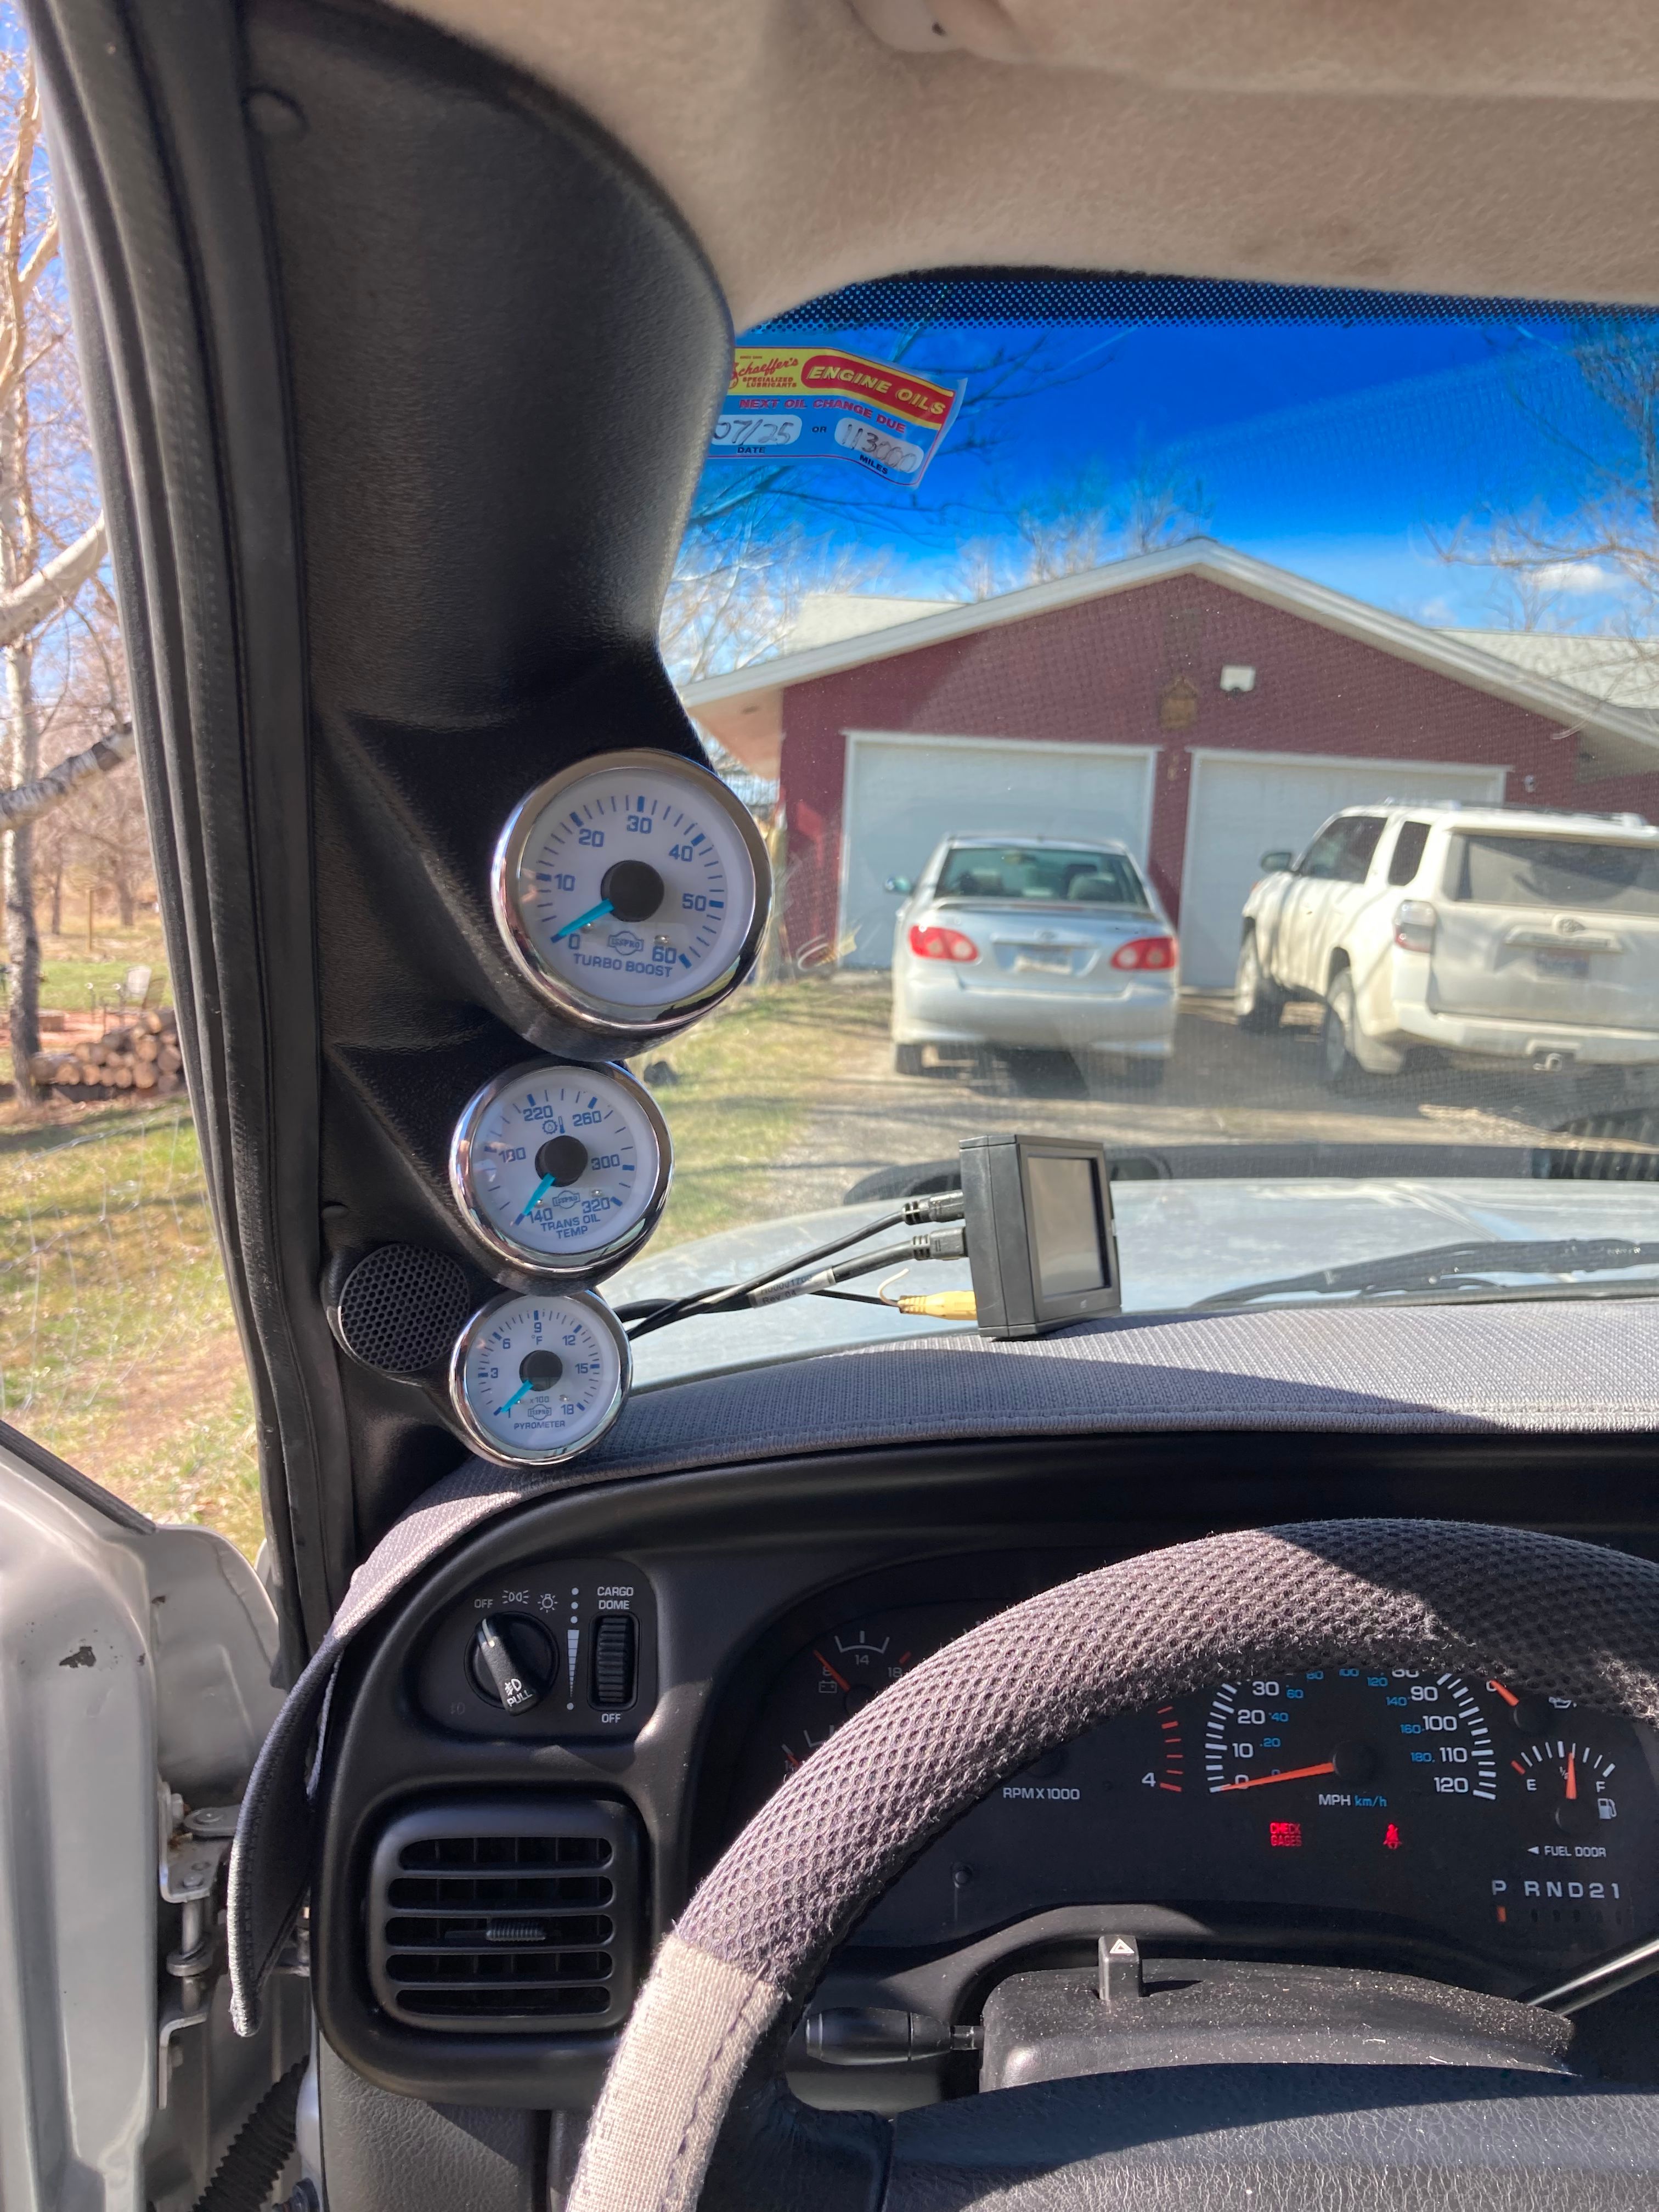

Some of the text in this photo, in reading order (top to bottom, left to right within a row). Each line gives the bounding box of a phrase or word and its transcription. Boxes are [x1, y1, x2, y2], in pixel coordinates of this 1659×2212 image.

[806, 366, 946, 415] ENGINE OILS
[739, 399, 906, 433] NEXT OIL CHANGE DUE
[714, 419, 794, 446] 07/25
[842, 424, 917, 472] 113000
[859, 454, 888, 475] MILES
[626, 816, 652, 834] 30
[578, 828, 605, 848] 20
[669, 844, 693, 862] 40
[554, 873, 575, 891] 10
[682, 893, 707, 912] 50
[568, 934, 580, 950] 0
[652, 946, 677, 964] 60
[573, 953, 674, 978] TURBO BOOST
[523, 1105, 554, 1121] 220
[572, 1110, 602, 1126] 260
[591, 1154, 620, 1171] 300
[582, 1197, 611, 1214] 320
[529, 1208, 553, 1224] 140
[540, 1212, 601, 1232] TRANS OIL
[556, 1225, 588, 1239] TEMP
[534, 1322, 542, 1333] 9
[503, 1338, 511, 1350] 6
[562, 1334, 576, 1346] 12
[490, 1368, 499, 1379] 3
[575, 1362, 589, 1374] 15
[561, 1404, 574, 1415] 18
[514, 1420, 566, 1430] PYROMETER
[597, 1587, 634, 1597] CARGO
[474, 1599, 493, 1609] OFF
[599, 1600, 630, 1610] DOME
[855, 1654, 870, 1666] 14
[887, 1666, 903, 1678] 18
[1252, 1681, 1280, 1696] 30
[1367, 1677, 1389, 1688] 120
[506, 1690, 533, 1707] PULL
[1286, 1689, 1304, 1699] 60
[1386, 1696, 1408, 1707] 140
[1410, 1686, 1438, 1702] 90
[601, 1713, 621, 1724] OFF
[1237, 1709, 1266, 1725] 20
[1271, 1712, 1289, 1723] 40
[1423, 1716, 1458, 1731] 100
[1400, 1724, 1422, 1735] 160
[1232, 1743, 1254, 1758] 10
[1263, 1738, 1281, 1748] 20
[1410, 1752, 1432, 1763] 180
[1440, 1747, 1468, 1763] 110
[1141, 1772, 1156, 1787] 4
[1434, 1777, 1469, 1793] 120
[1526, 1779, 1537, 1791] E
[1595, 1781, 1606, 1793] F
[1318, 1794, 1387, 1807] MPH km/h
[1270, 1822, 1301, 1834] CHECK
[1271, 1835, 1302, 1847] GAGES
[1544, 1845, 1607, 1858] FUEL DOOR
[1491, 1880, 1507, 1895] P
